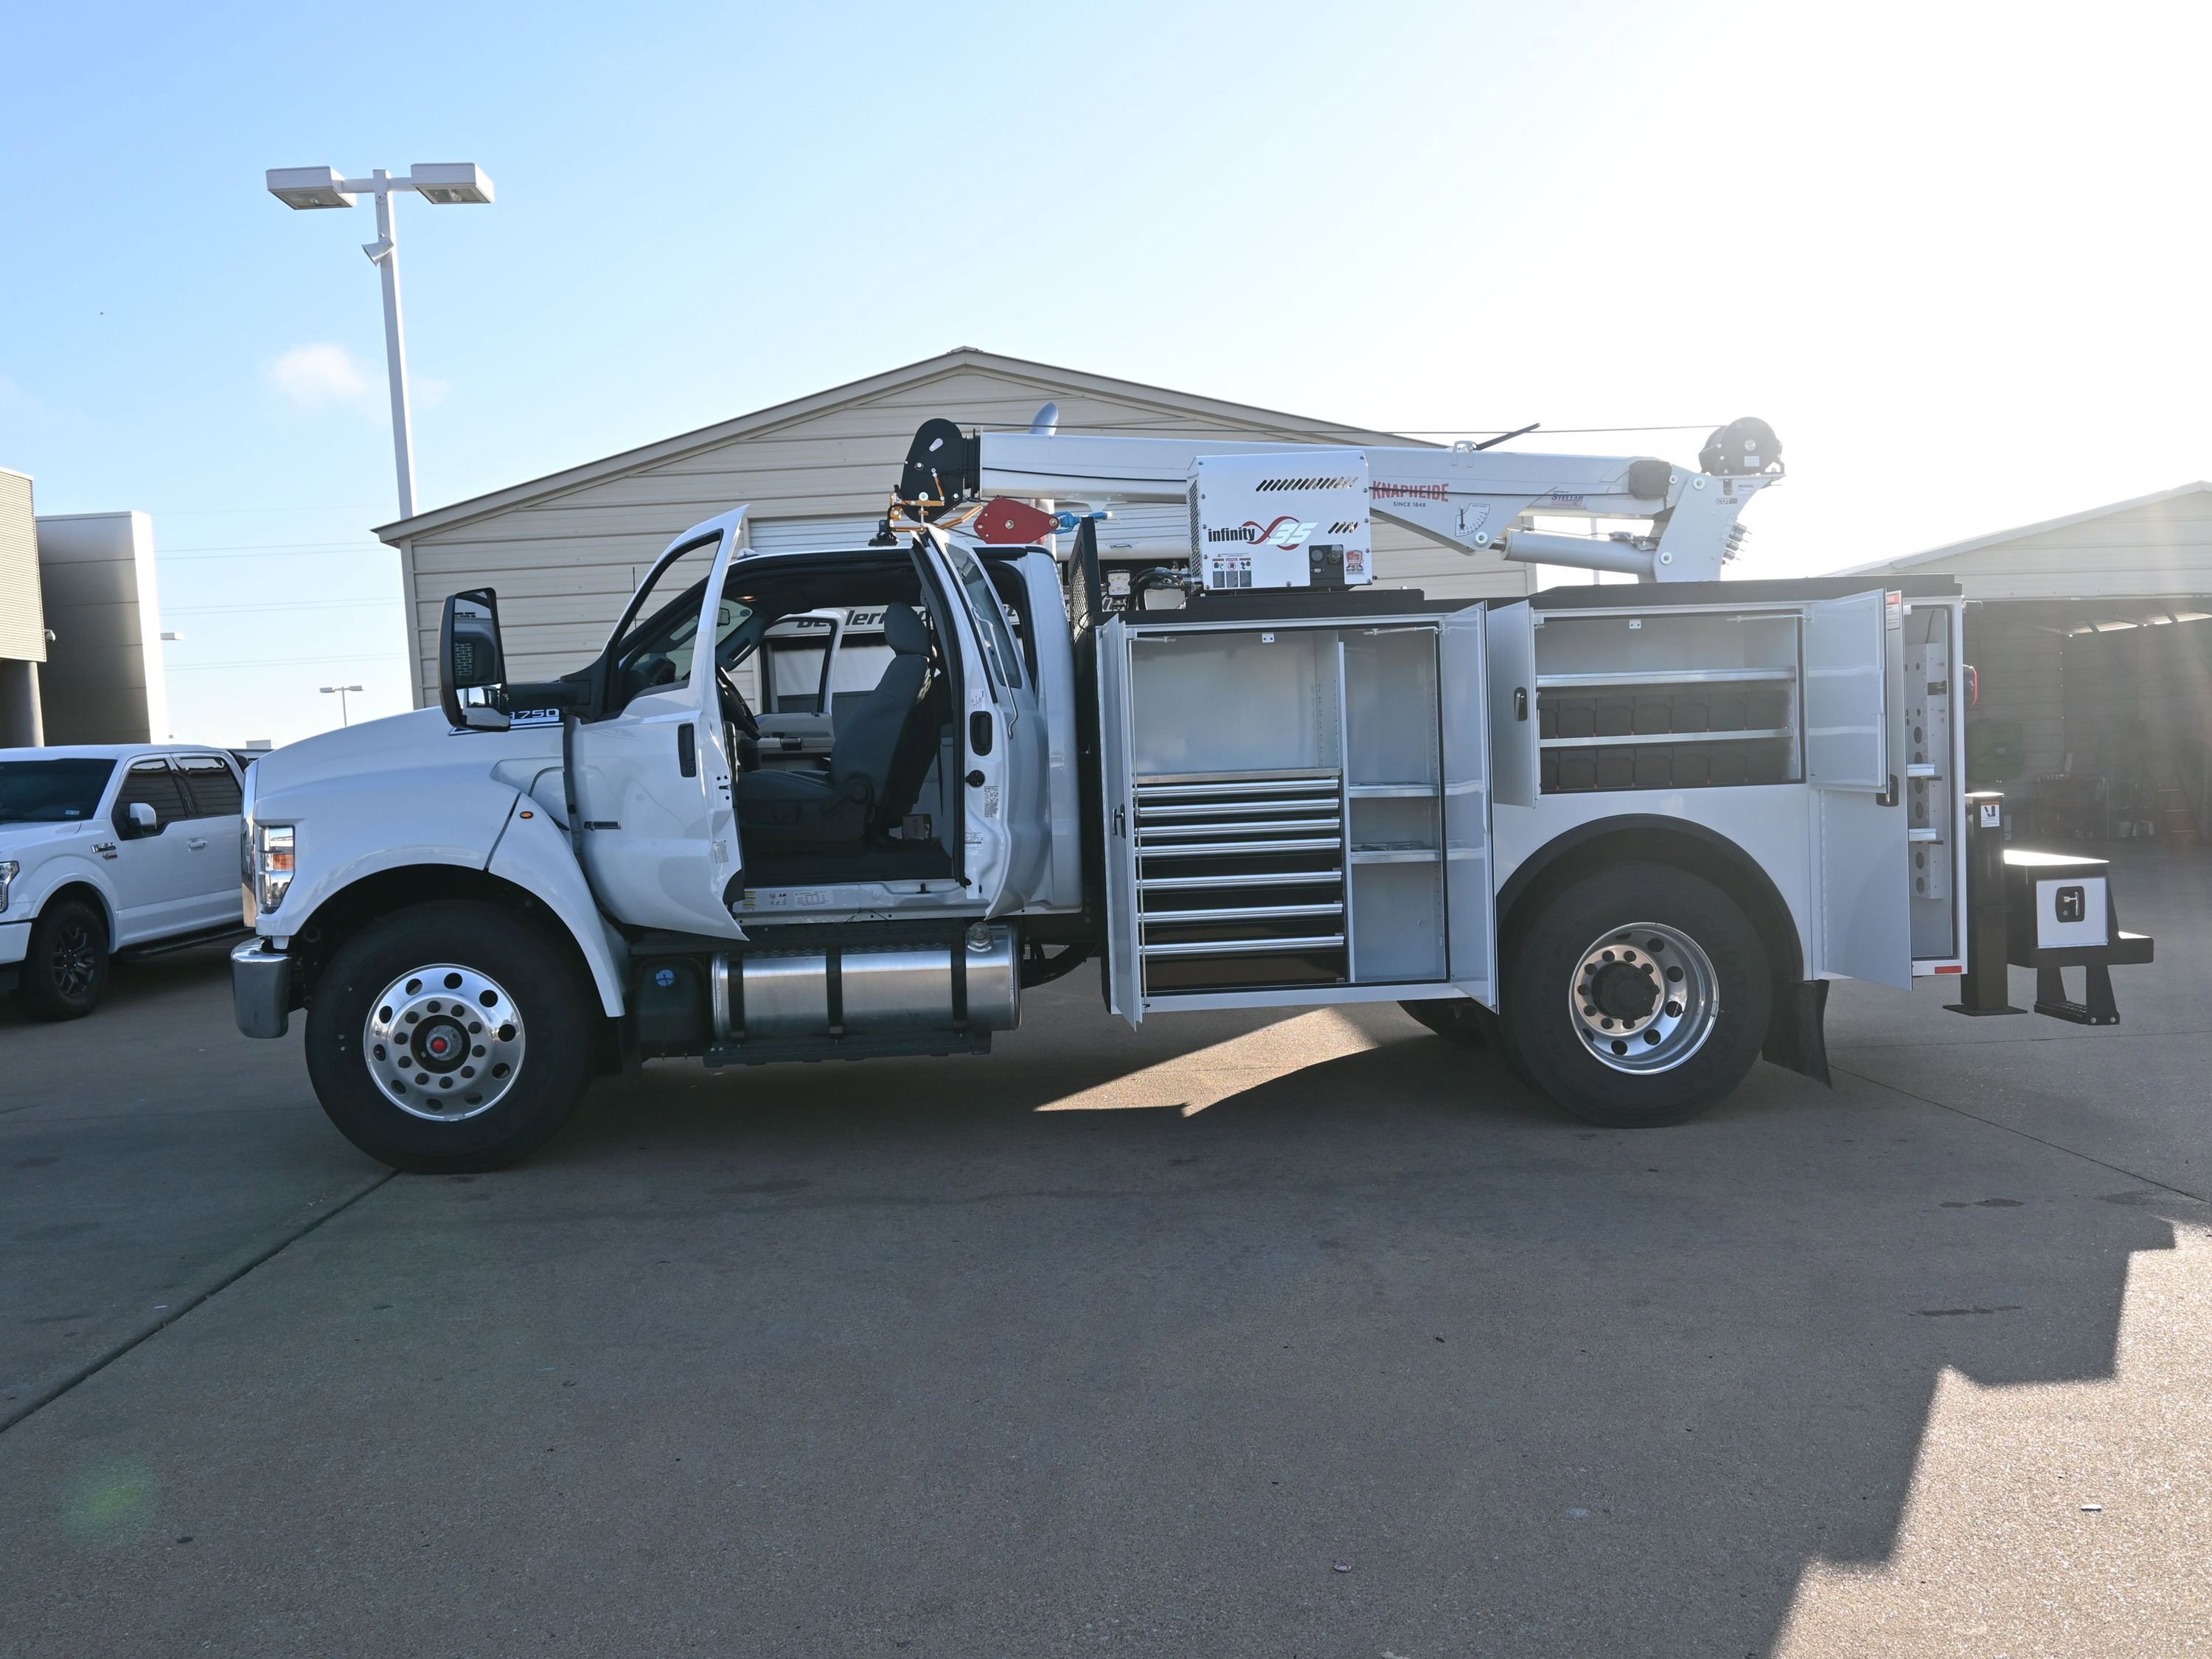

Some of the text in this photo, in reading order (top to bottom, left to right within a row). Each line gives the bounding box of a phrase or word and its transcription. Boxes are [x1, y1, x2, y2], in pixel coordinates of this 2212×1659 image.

[1372, 480, 1449, 502] KNAPHEIDE
[1208, 522, 1318, 545] infinity 35
